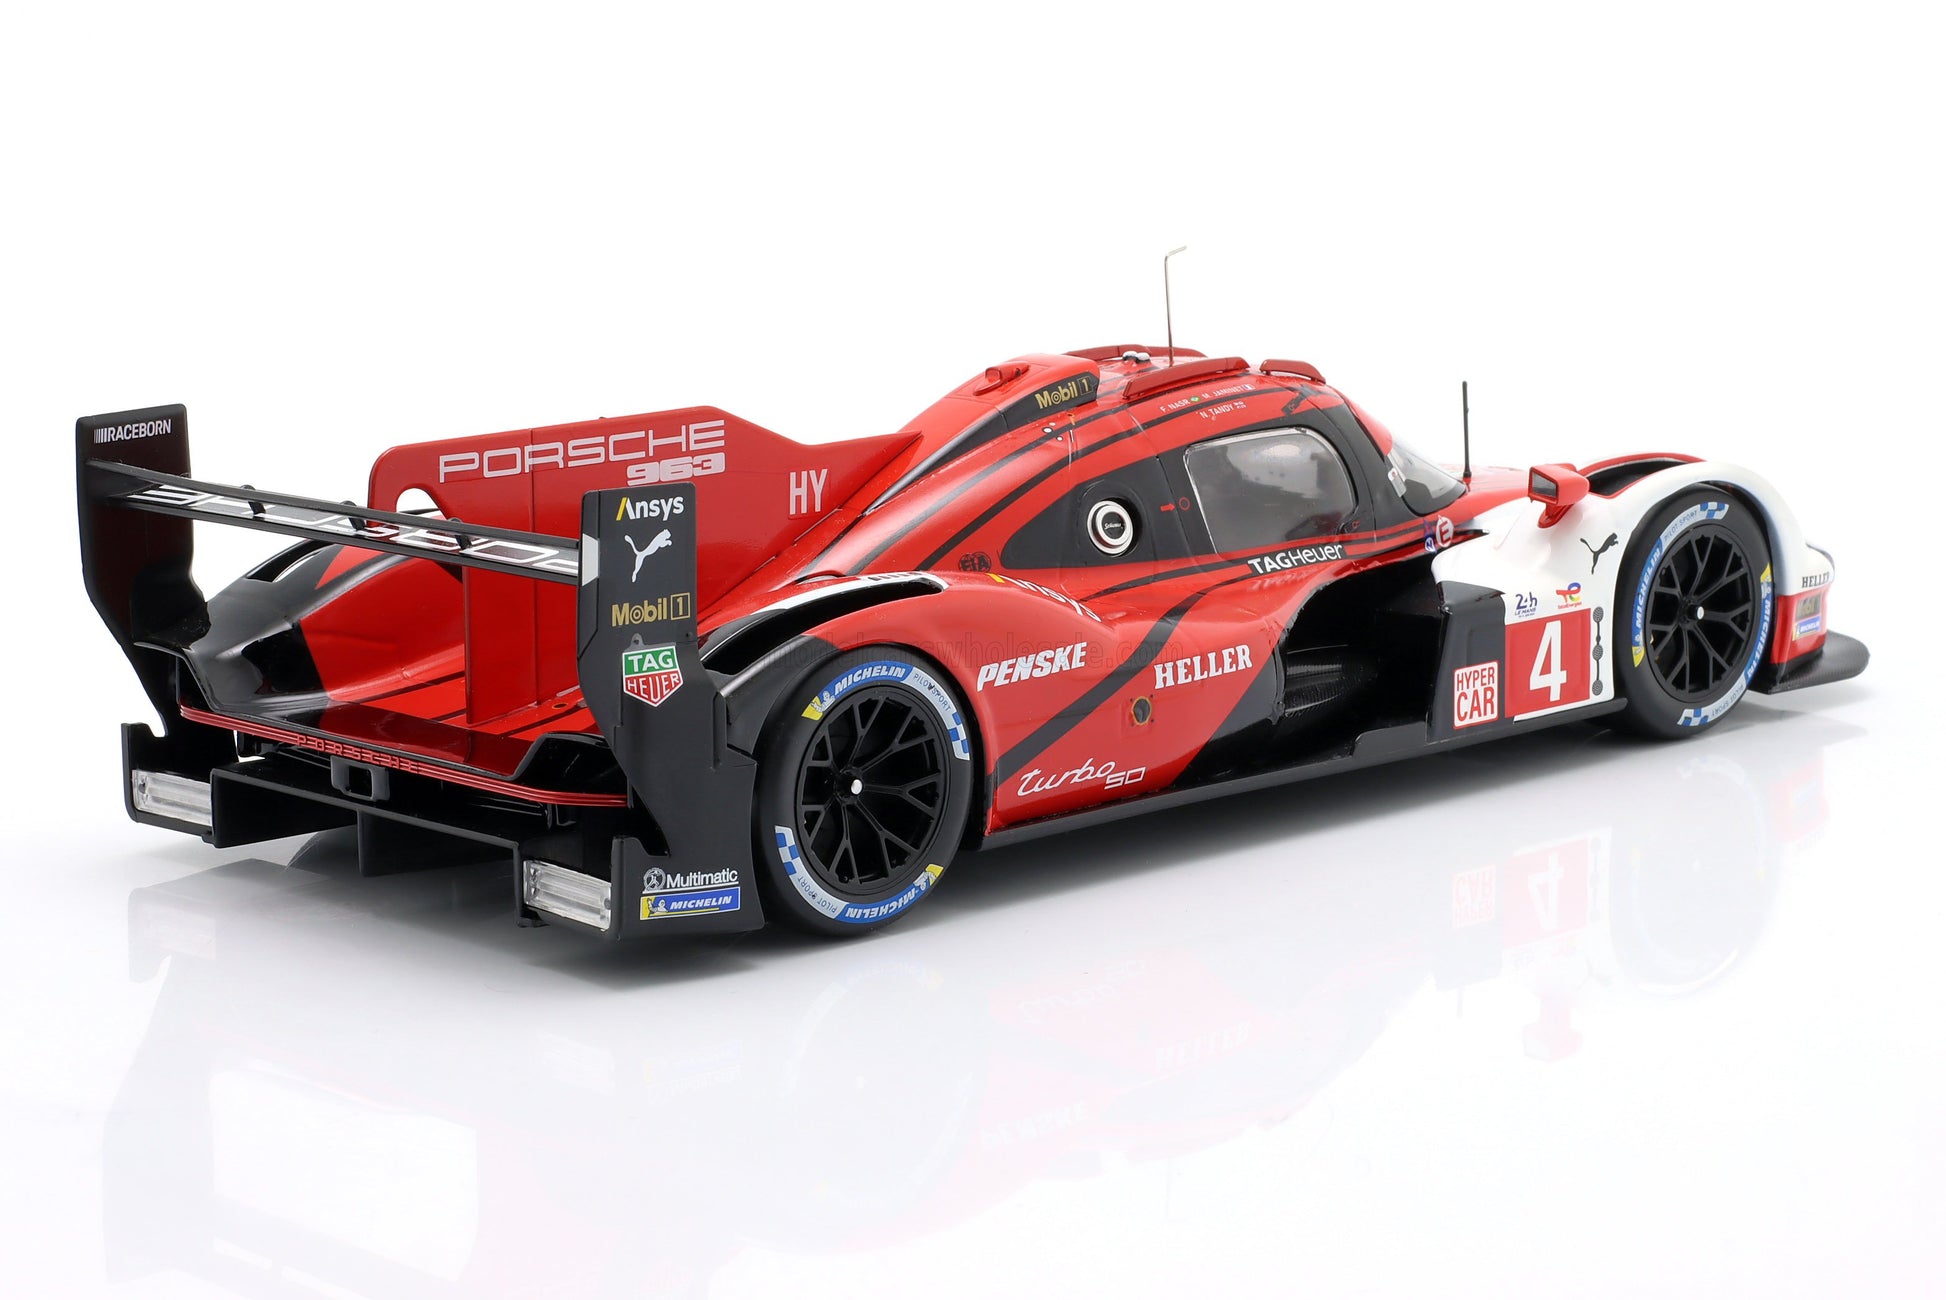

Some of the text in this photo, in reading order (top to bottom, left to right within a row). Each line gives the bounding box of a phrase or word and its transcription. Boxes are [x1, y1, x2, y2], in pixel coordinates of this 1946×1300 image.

[1035, 381, 1078, 409] Mobil
[1169, 399, 1190, 411] NASR
[1209, 404, 1234, 416] TANDY
[107, 418, 172, 442] RACEBORN
[439, 419, 725, 483] PORSCHE
[626, 452, 726, 486] 963
[789, 468, 828, 516] HY
[616, 496, 684, 521] Ansys
[1635, 548, 1661, 630] MICHELIN
[611, 597, 667, 627] Mobil
[628, 650, 673, 673] TAG
[976, 641, 1088, 693] PENSKE
[1154, 643, 1253, 689] HELLER
[1529, 619, 1567, 702] 4
[627, 673, 680, 703] HEUER
[834, 665, 906, 696] MICHELIN
[1456, 666, 1495, 692] HYPER
[1456, 686, 1495, 722] CAR
[1017, 757, 1146, 796] turbo 50
[666, 868, 738, 888] Multimatic
[670, 896, 732, 910] MICHELIN
[845, 887, 917, 919] MICHELIN
